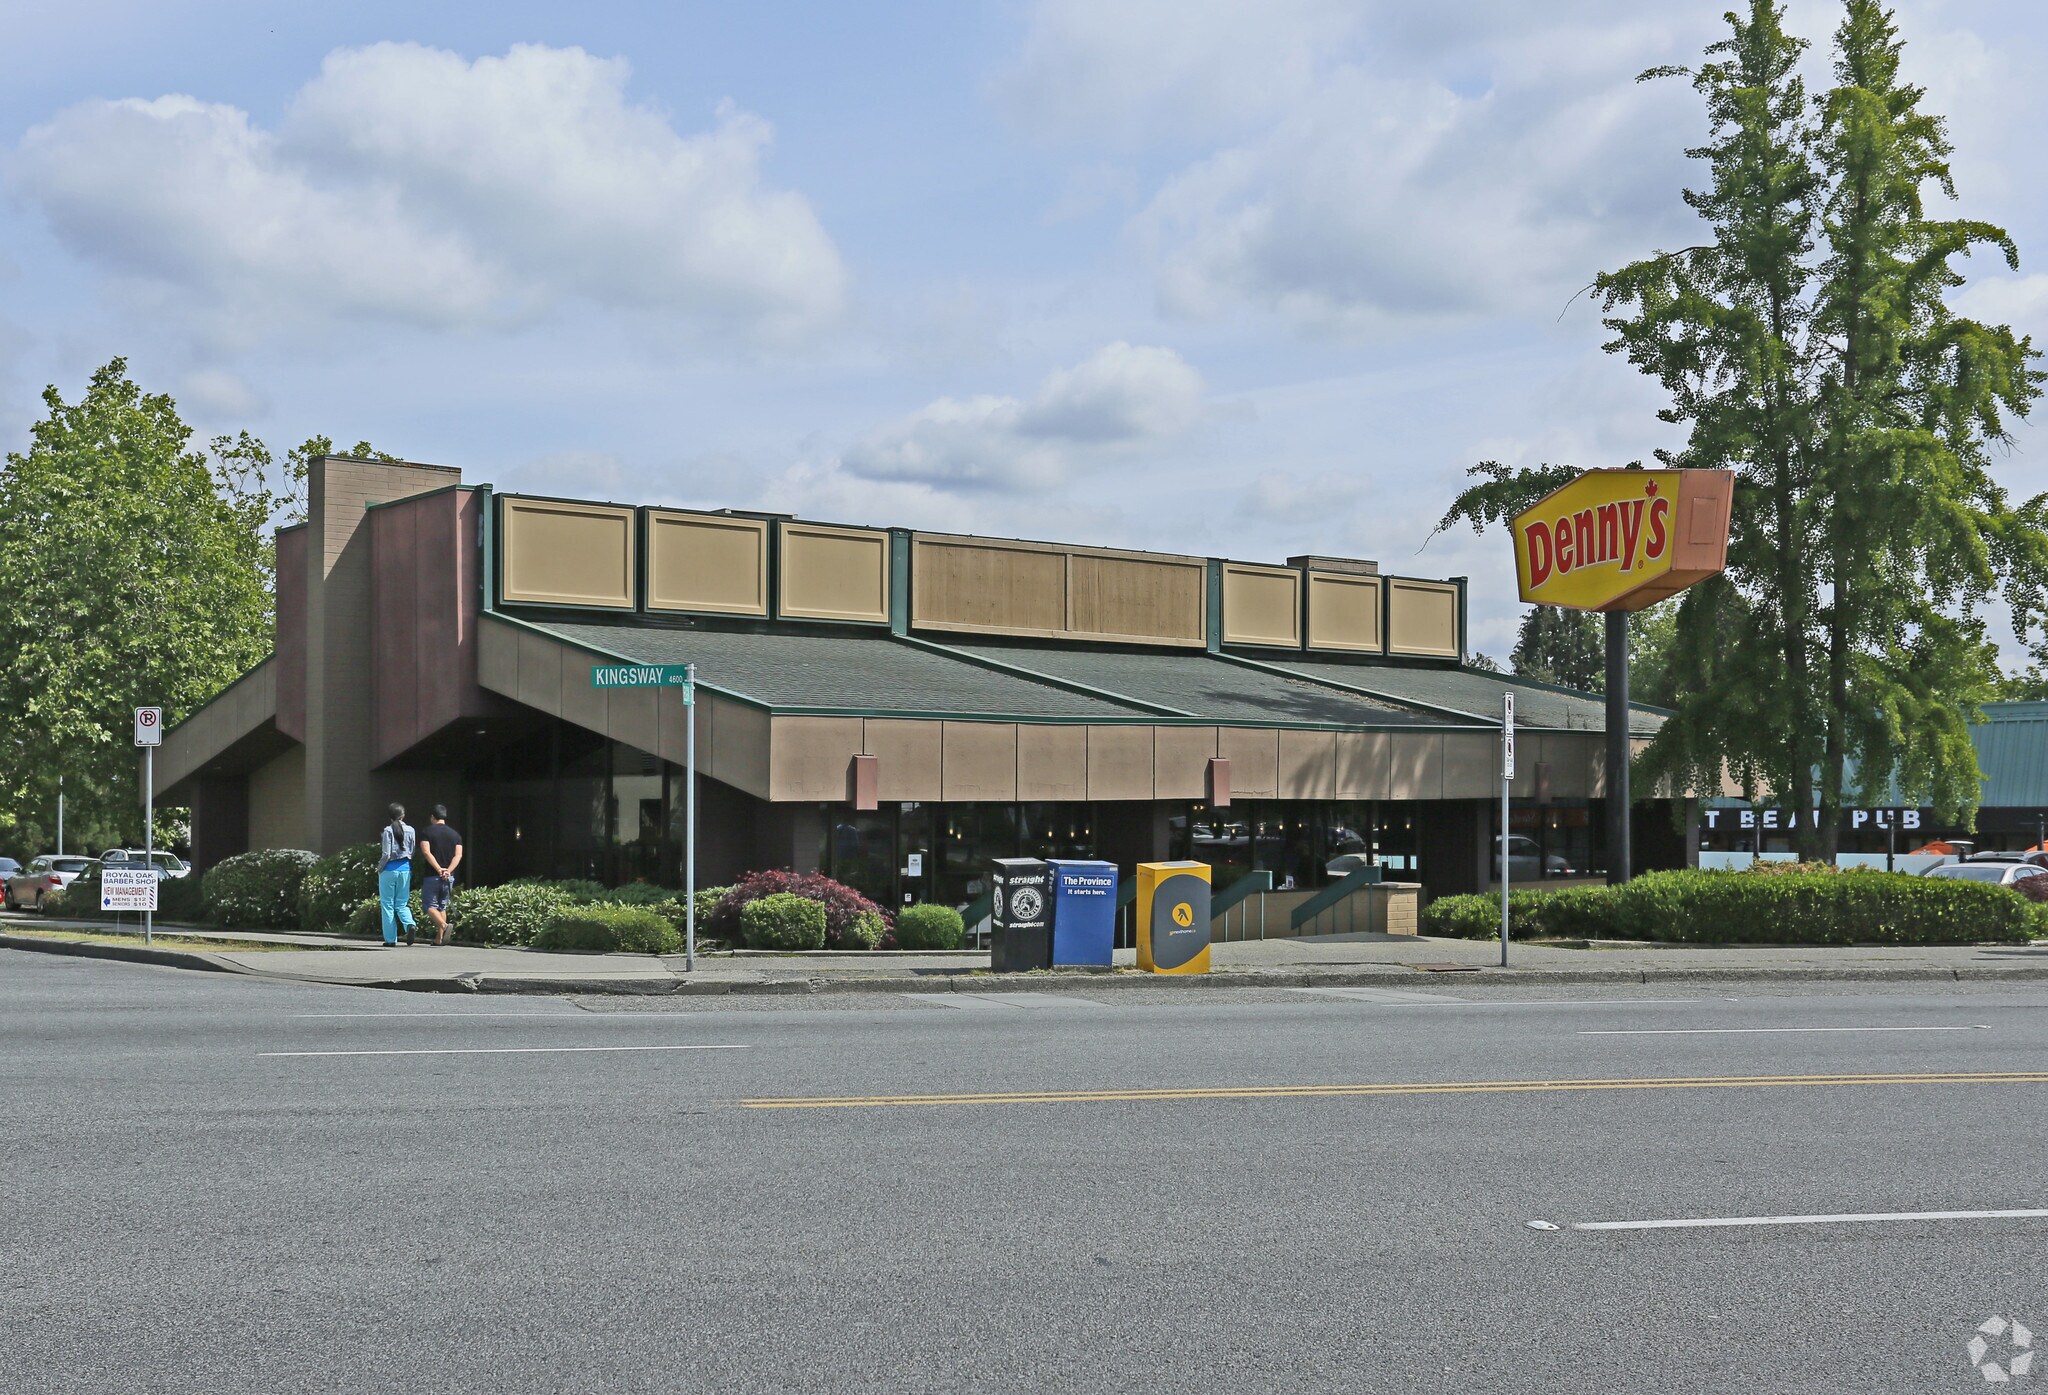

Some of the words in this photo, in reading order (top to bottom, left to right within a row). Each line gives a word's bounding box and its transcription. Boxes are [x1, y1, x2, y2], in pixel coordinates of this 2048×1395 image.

[1524, 478, 1670, 591] Denny's
[596, 667, 664, 685] KINGSWAY
[669, 675, 683, 683] 4600
[1852, 810, 1921, 829] PUB
[1009, 876, 1045, 885] straight
[1063, 876, 1078, 885] The
[1078, 876, 1112, 886] Province
[103, 887, 115, 895] NEW
[115, 887, 147, 895] MANAGEMENT
